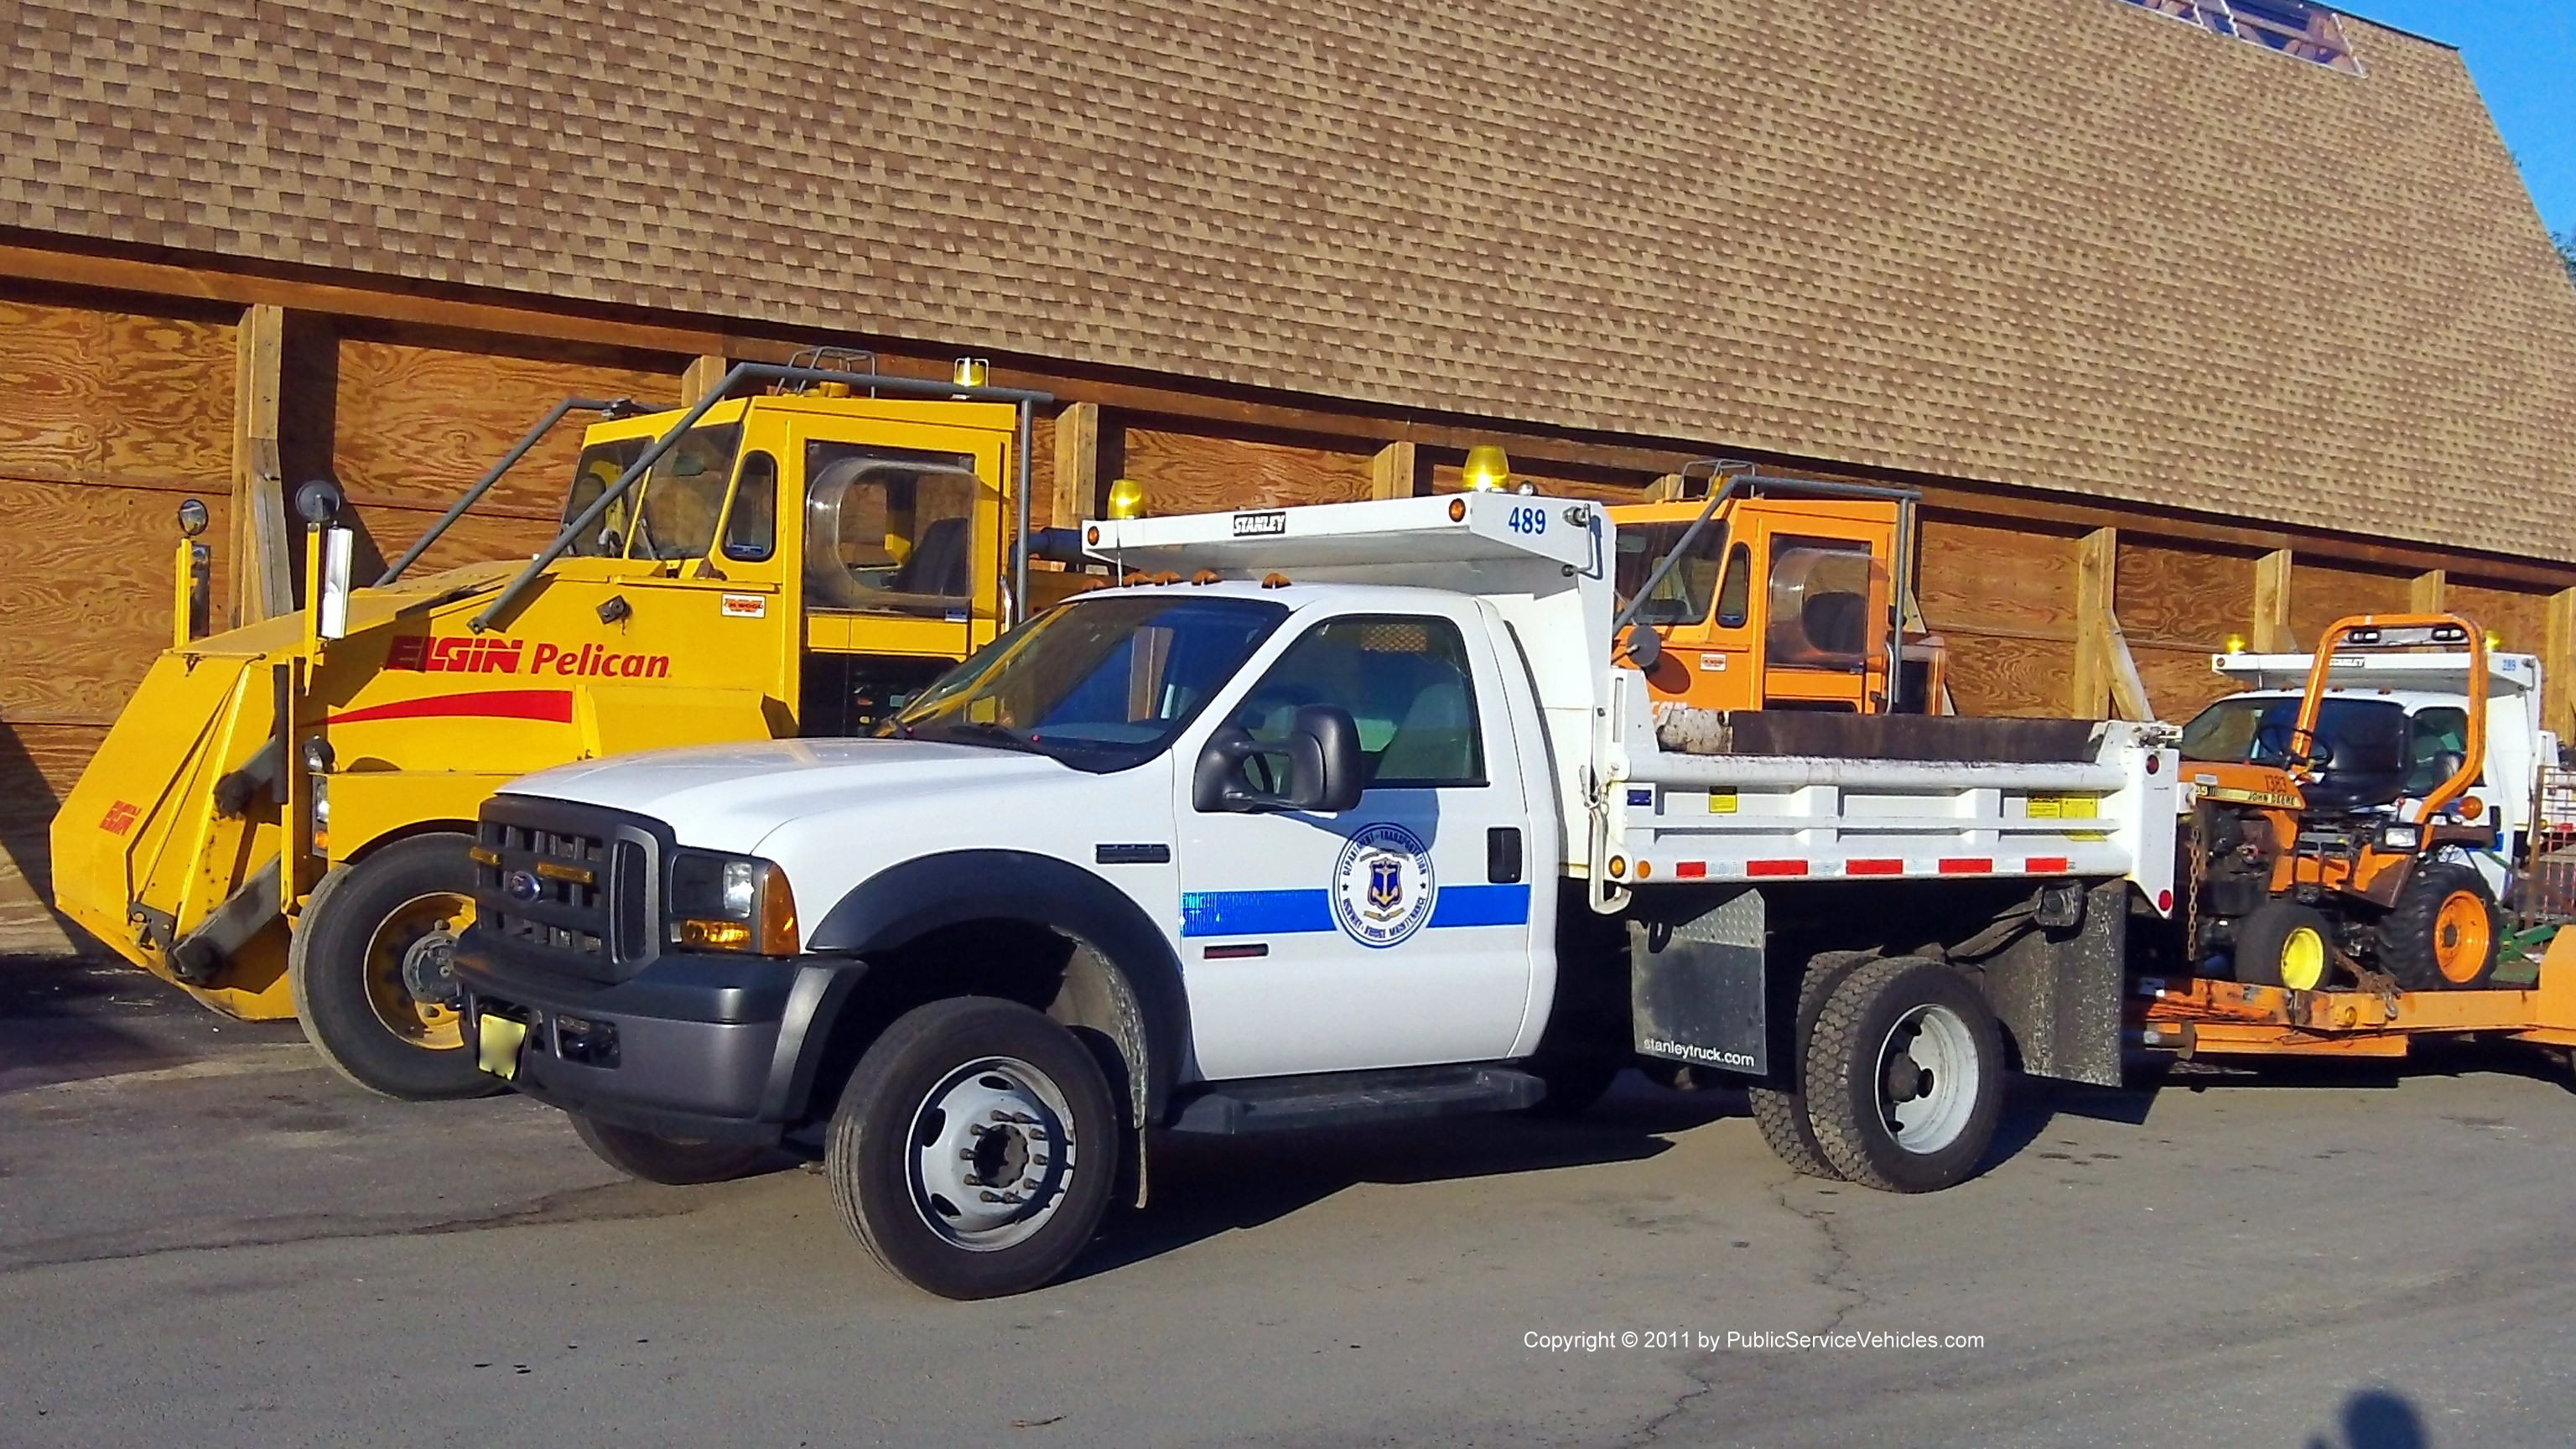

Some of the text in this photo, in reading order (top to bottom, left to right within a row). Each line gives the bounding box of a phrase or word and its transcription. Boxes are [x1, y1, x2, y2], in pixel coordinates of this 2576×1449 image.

[1233, 514, 1286, 534] STANLEY
[1509, 506, 1546, 535] 489
[384, 636, 670, 678] ELGIN Pelican
[1644, 1038, 1755, 1067] stanleytruck.com
